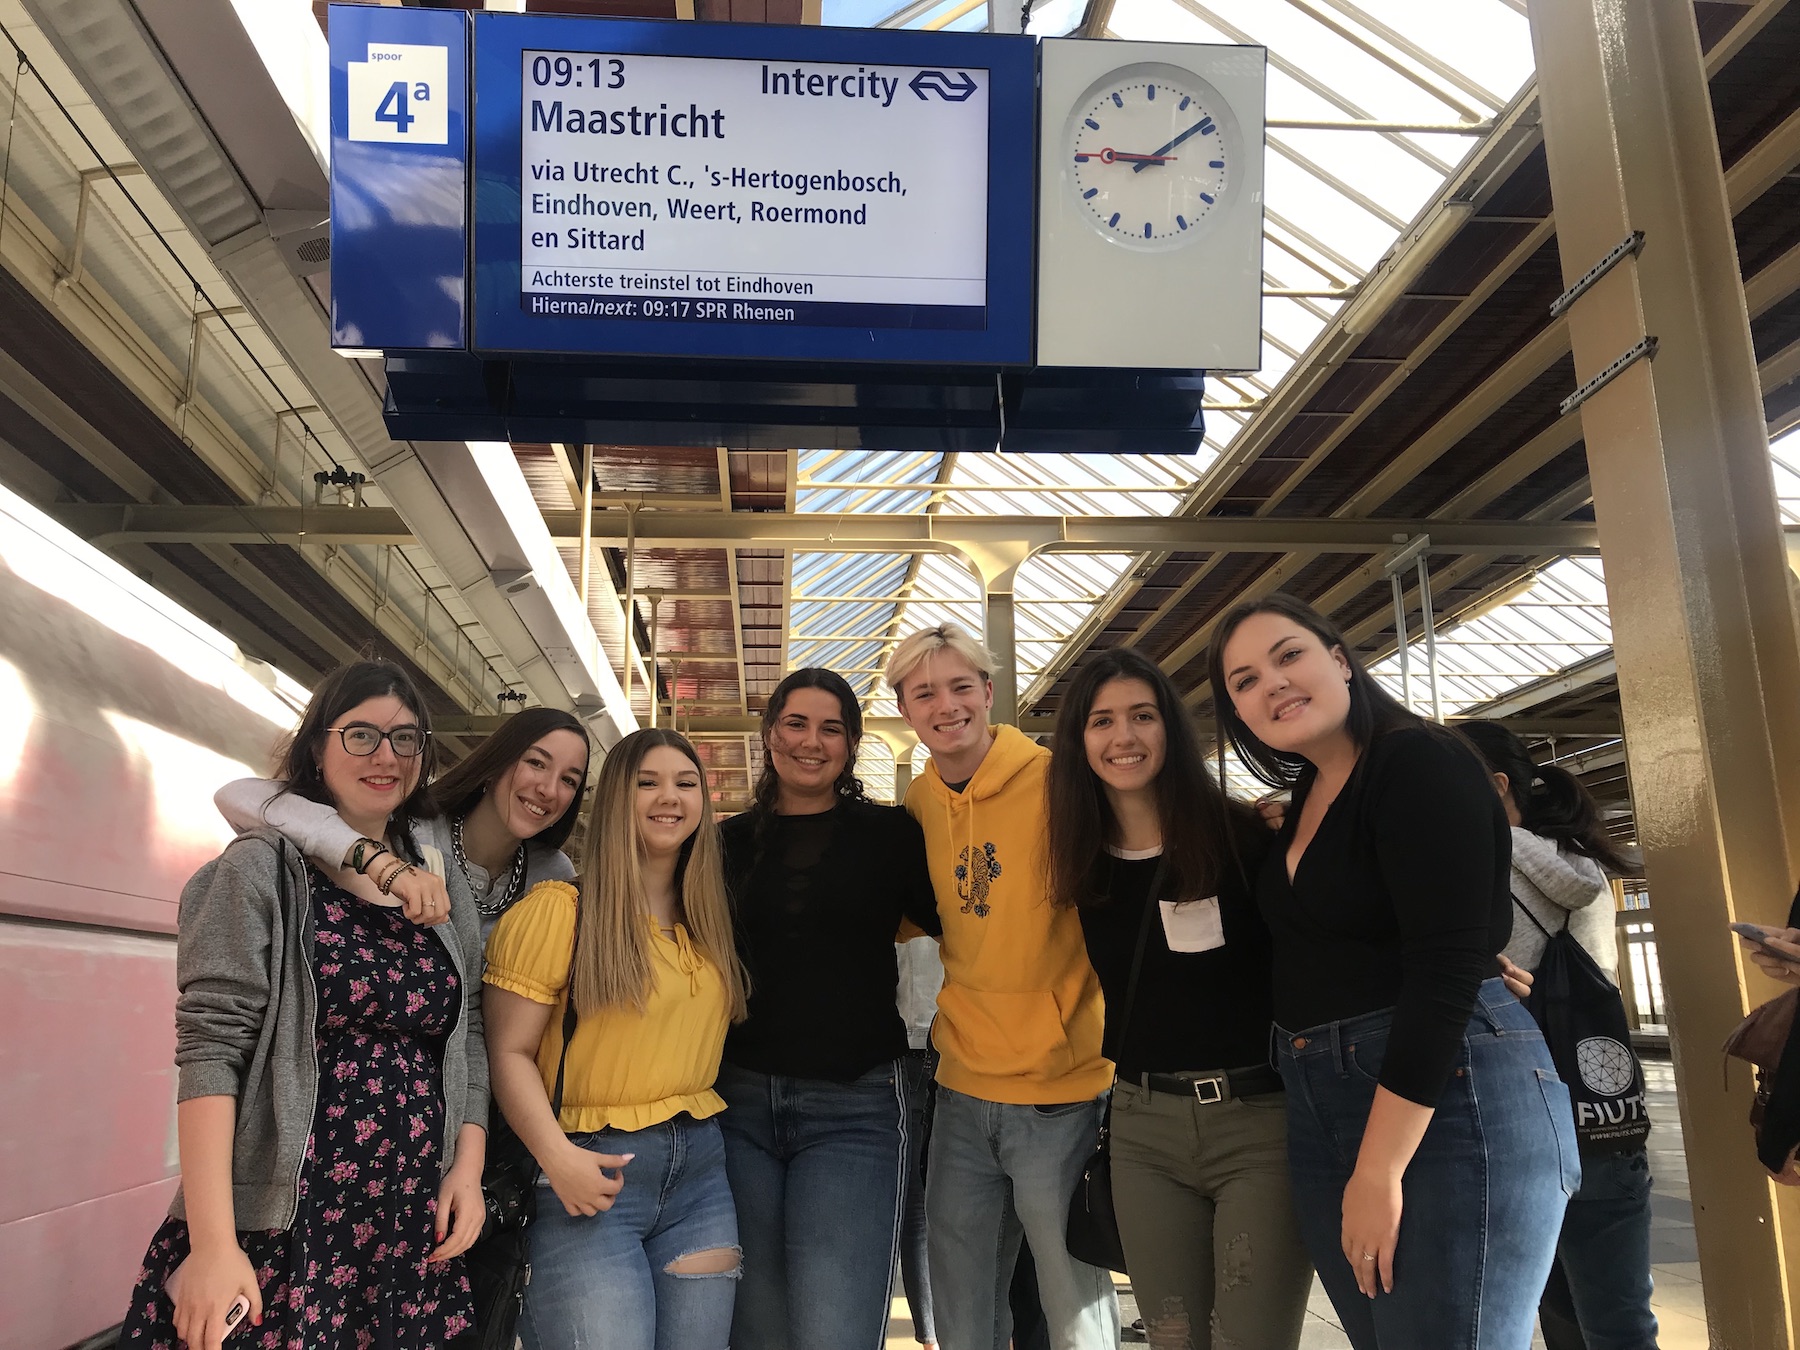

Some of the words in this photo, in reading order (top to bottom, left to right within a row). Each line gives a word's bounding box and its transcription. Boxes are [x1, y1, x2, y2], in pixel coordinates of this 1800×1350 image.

[371, 51, 403, 62] spoor
[532, 56, 626, 89] 09:13
[762, 65, 899, 107] Intercity
[531, 100, 725, 138] Maastricht
[531, 159, 565, 181] via
[574, 161, 659, 185] Utrecht
[667, 165, 695, 188] C.,
[705, 165, 908, 196] 's-Hertogenbosch,
[532, 193, 658, 221] Eindhoven,
[667, 198, 742, 224] Weert,
[751, 201, 867, 225] Roermond
[531, 231, 559, 248] en
[567, 228, 645, 251] Sittard
[531, 270, 614, 288] Achterste
[619, 273, 690, 291] treinstel
[696, 276, 721, 292] tot
[727, 276, 814, 295] Eindhoven
[532, 296, 638, 315] Hierna/next:
[642, 300, 691, 318] 09:17
[696, 302, 727, 319] SPR
[733, 303, 795, 321] Rhenen
